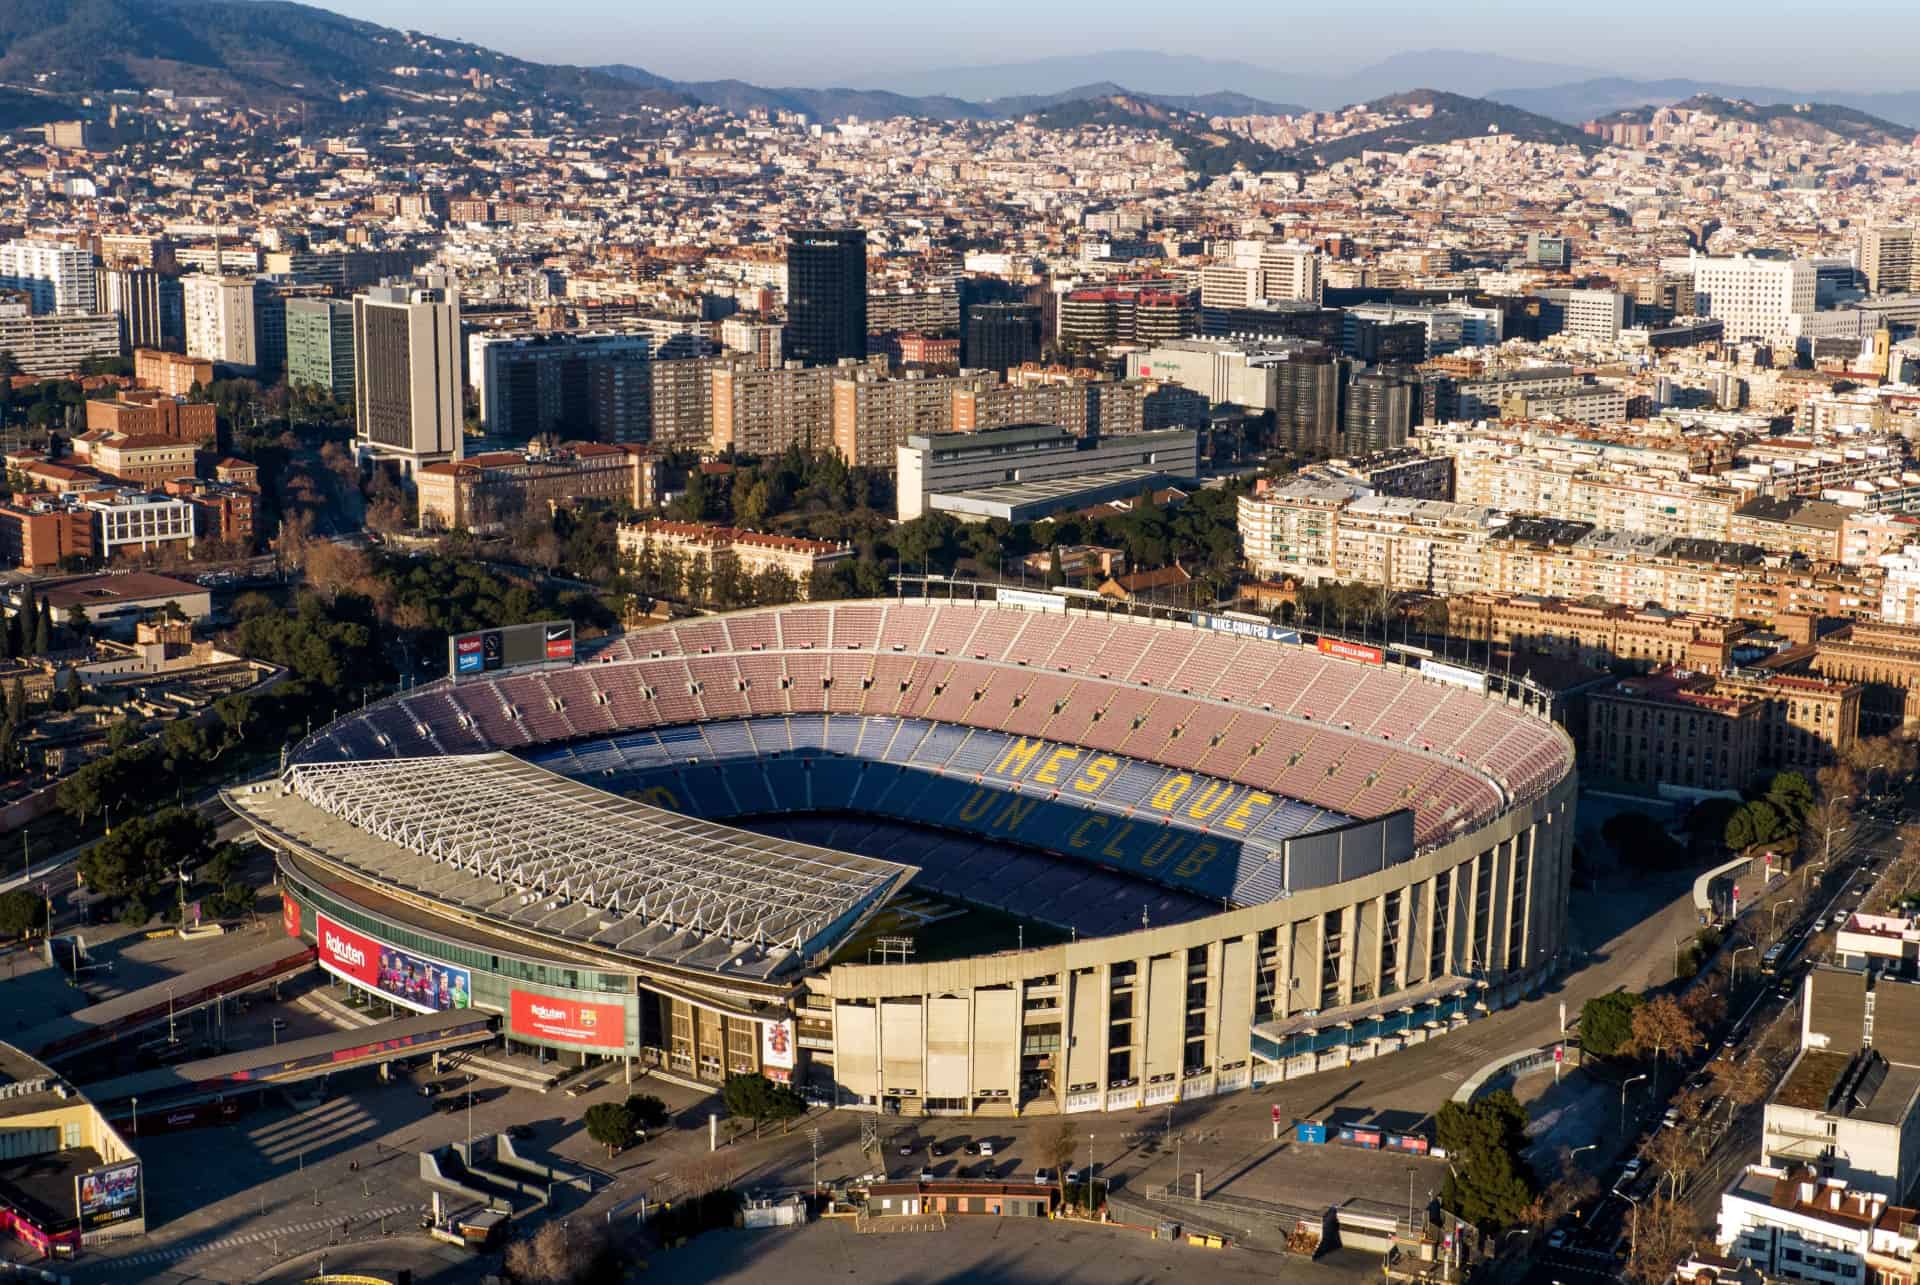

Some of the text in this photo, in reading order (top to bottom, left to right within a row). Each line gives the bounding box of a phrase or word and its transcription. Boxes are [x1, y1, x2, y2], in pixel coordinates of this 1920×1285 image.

[995, 736, 1272, 831] MES QUE
[958, 790, 1217, 878] UN CLUB
[325, 931, 365, 967] Rakuten
[531, 1004, 566, 1020] Rakuten
